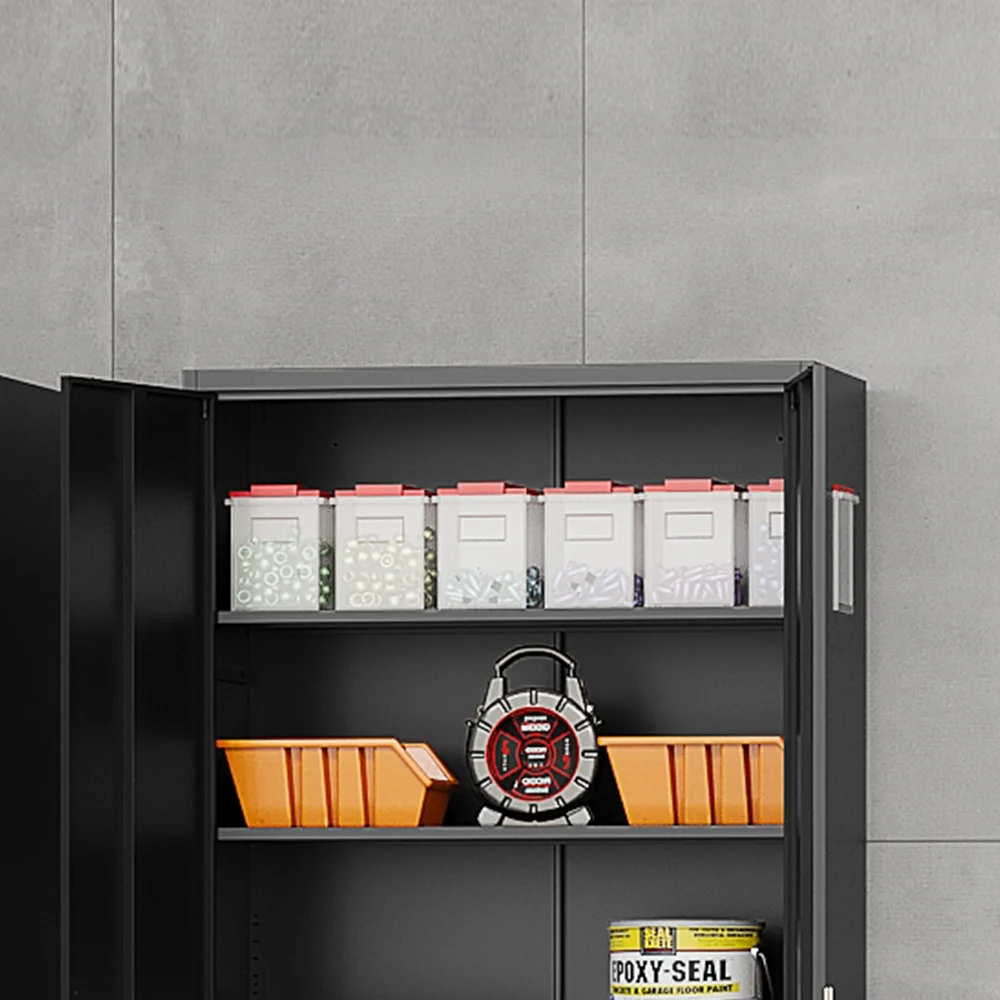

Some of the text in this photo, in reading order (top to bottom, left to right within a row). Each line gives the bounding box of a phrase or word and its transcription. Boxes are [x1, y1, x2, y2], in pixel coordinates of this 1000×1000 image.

[641, 986, 674, 995] GARAGE
[676, 985, 704, 995] FLOOR
[706, 984, 733, 993] PAINT
